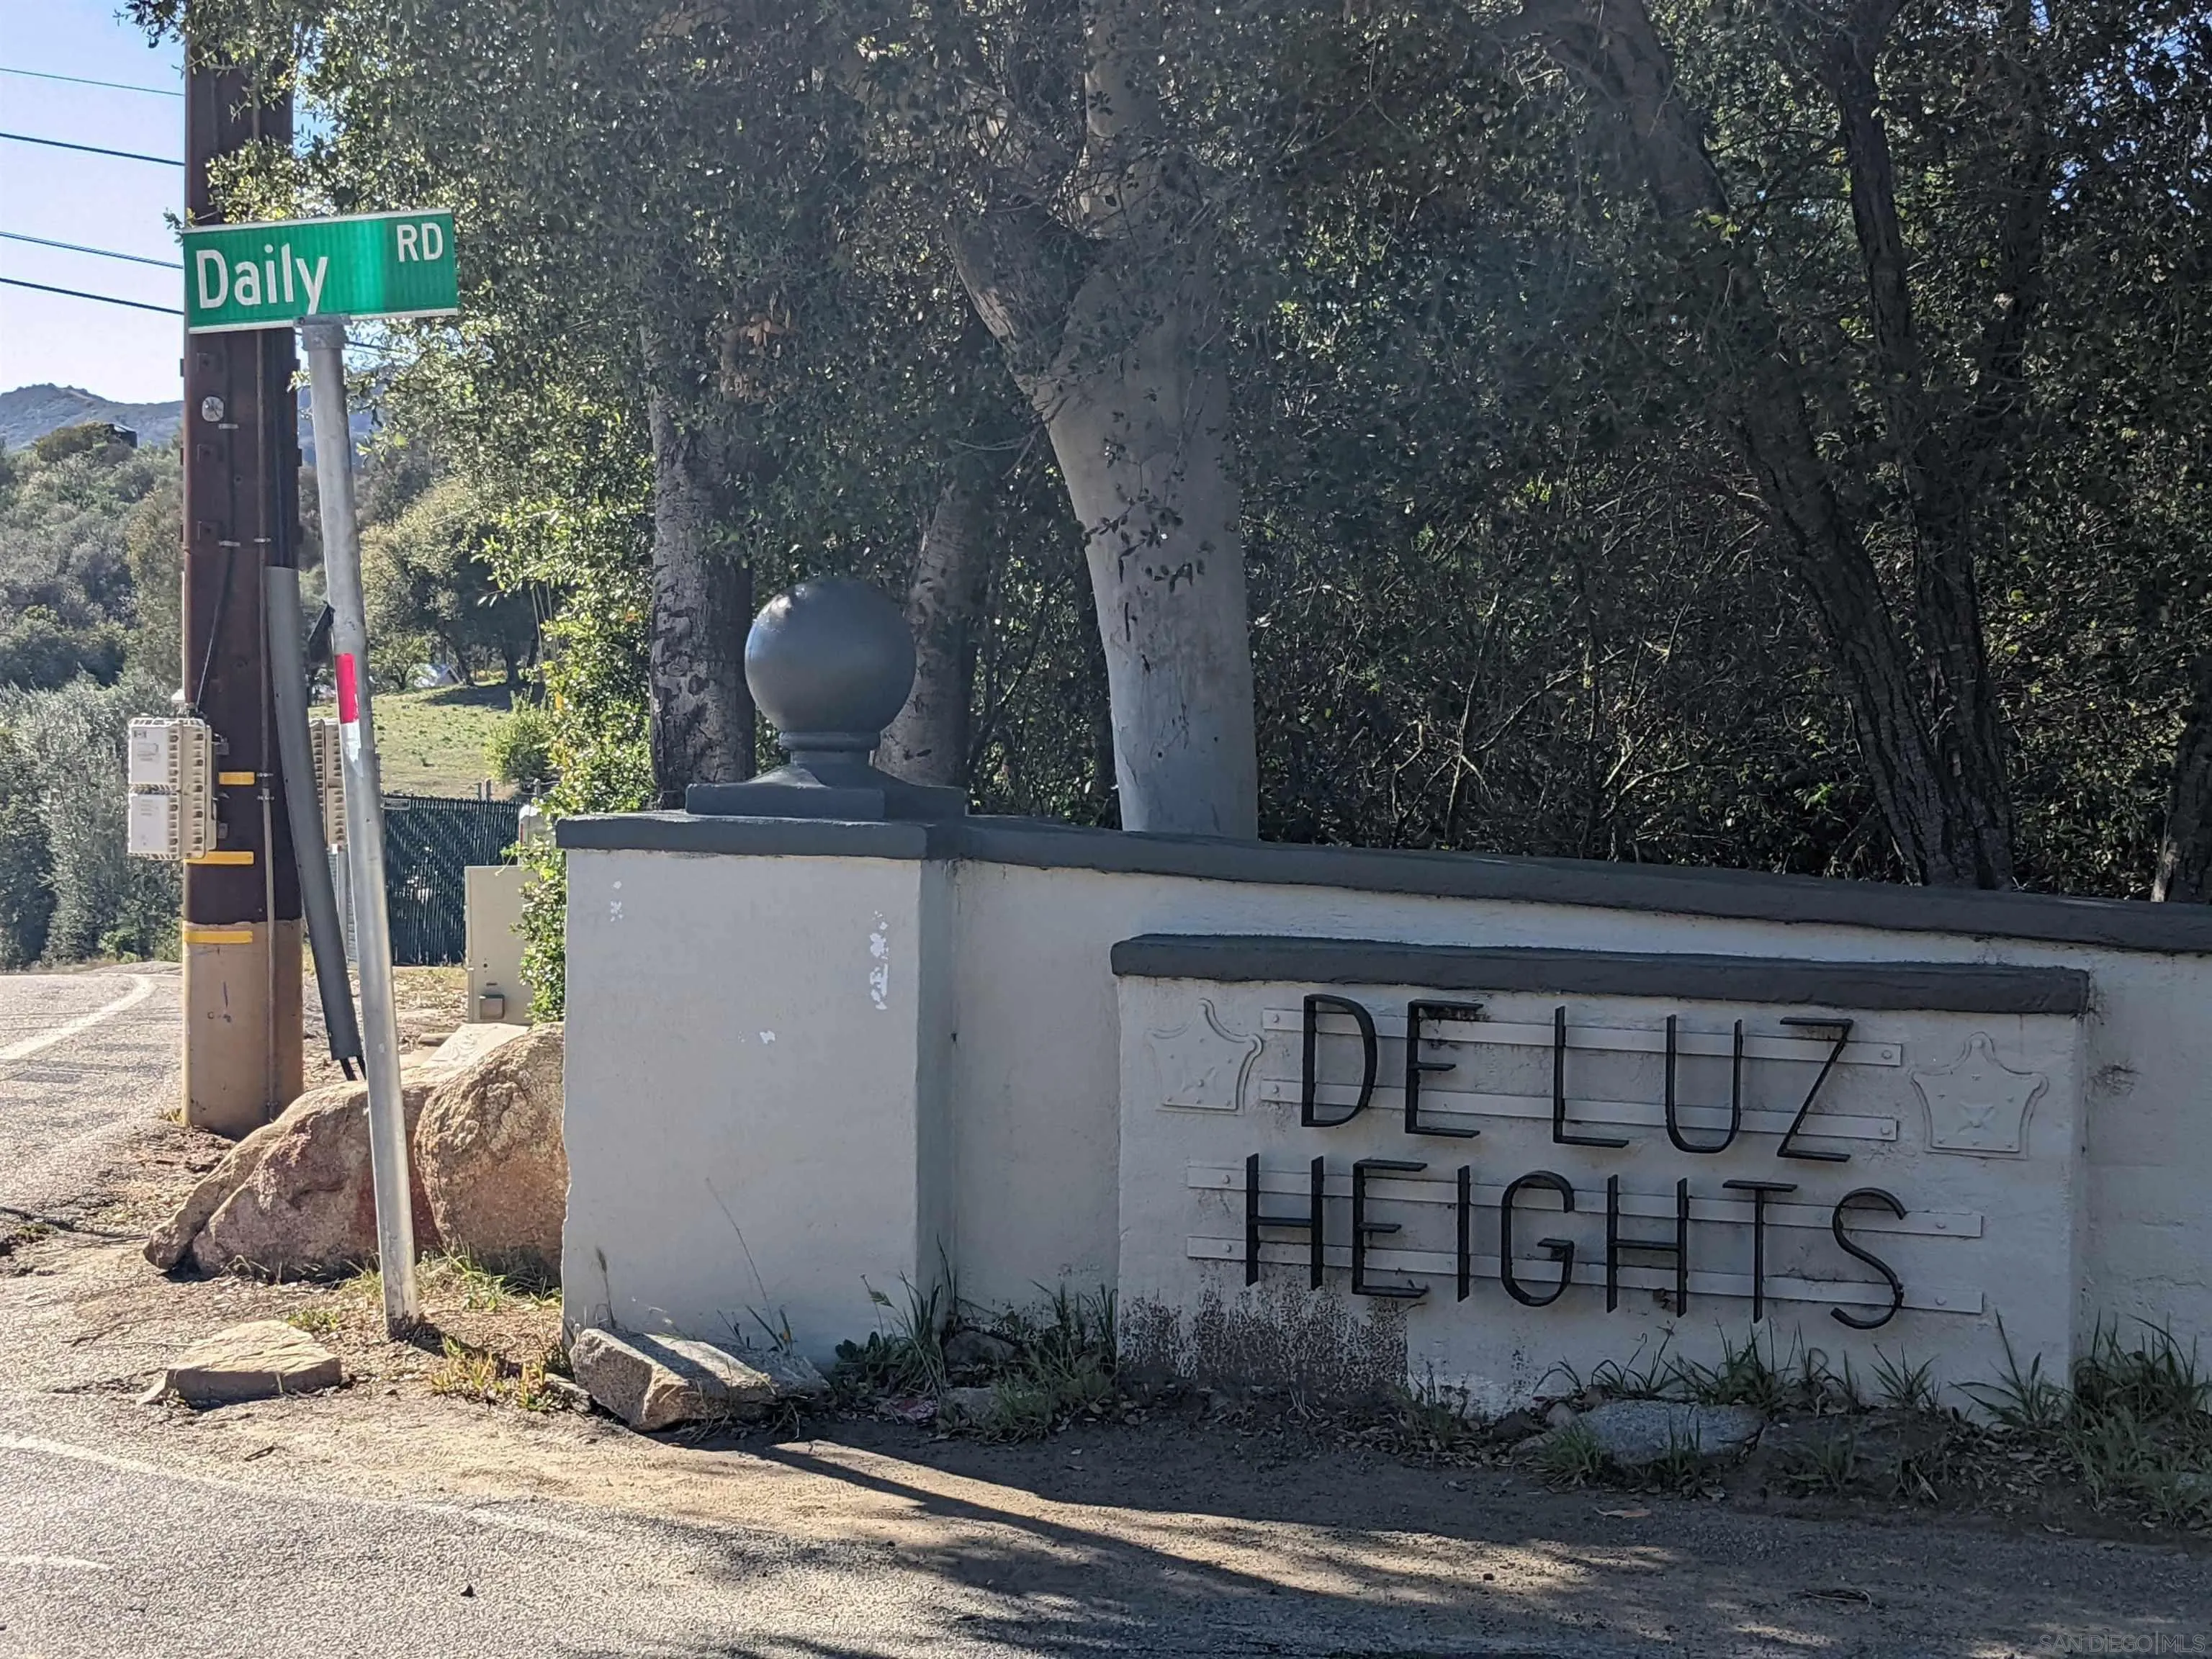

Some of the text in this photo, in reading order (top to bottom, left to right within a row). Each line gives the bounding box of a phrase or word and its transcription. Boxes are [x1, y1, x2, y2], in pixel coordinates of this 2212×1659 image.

[196, 222, 443, 315] Daily RD
[1301, 993, 1854, 1162] DE LUZ
[1246, 1153, 1907, 1329] HEIGHTS
